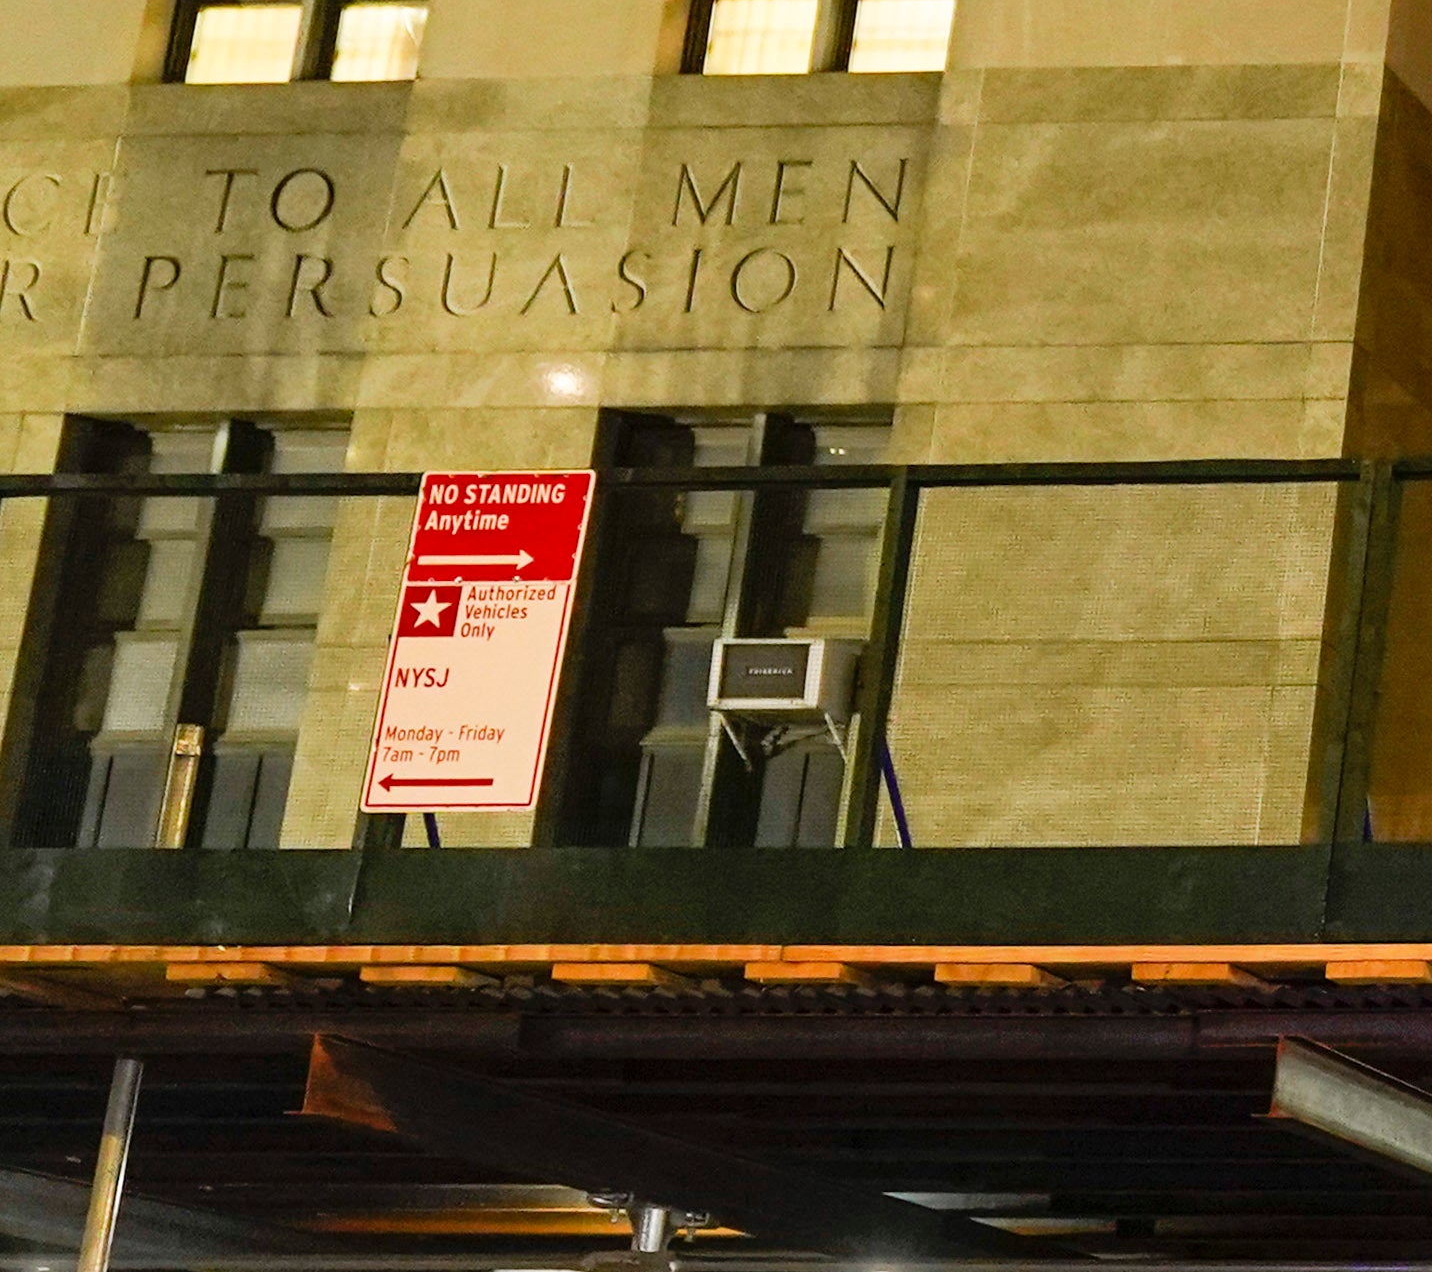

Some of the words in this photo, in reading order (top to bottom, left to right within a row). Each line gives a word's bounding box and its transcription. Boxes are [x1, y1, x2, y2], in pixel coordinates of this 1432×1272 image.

[205, 167, 335, 232] TO
[402, 162, 596, 229] ALL
[672, 158, 908, 226] MEN
[133, 245, 895, 320] PERSUASION
[429, 484, 459, 504] NO
[463, 483, 567, 504] STANDING
[424, 510, 510, 535] Anytime
[466, 585, 556, 602] Authorized
[465, 604, 528, 620] Vehicles
[460, 623, 495, 641] Only
[395, 668, 449, 688] NYSJ
[384, 725, 443, 743] Monday
[458, 725, 506, 744] Friday
[382, 746, 413, 762] 7am
[429, 746, 460, 765] 7pm
